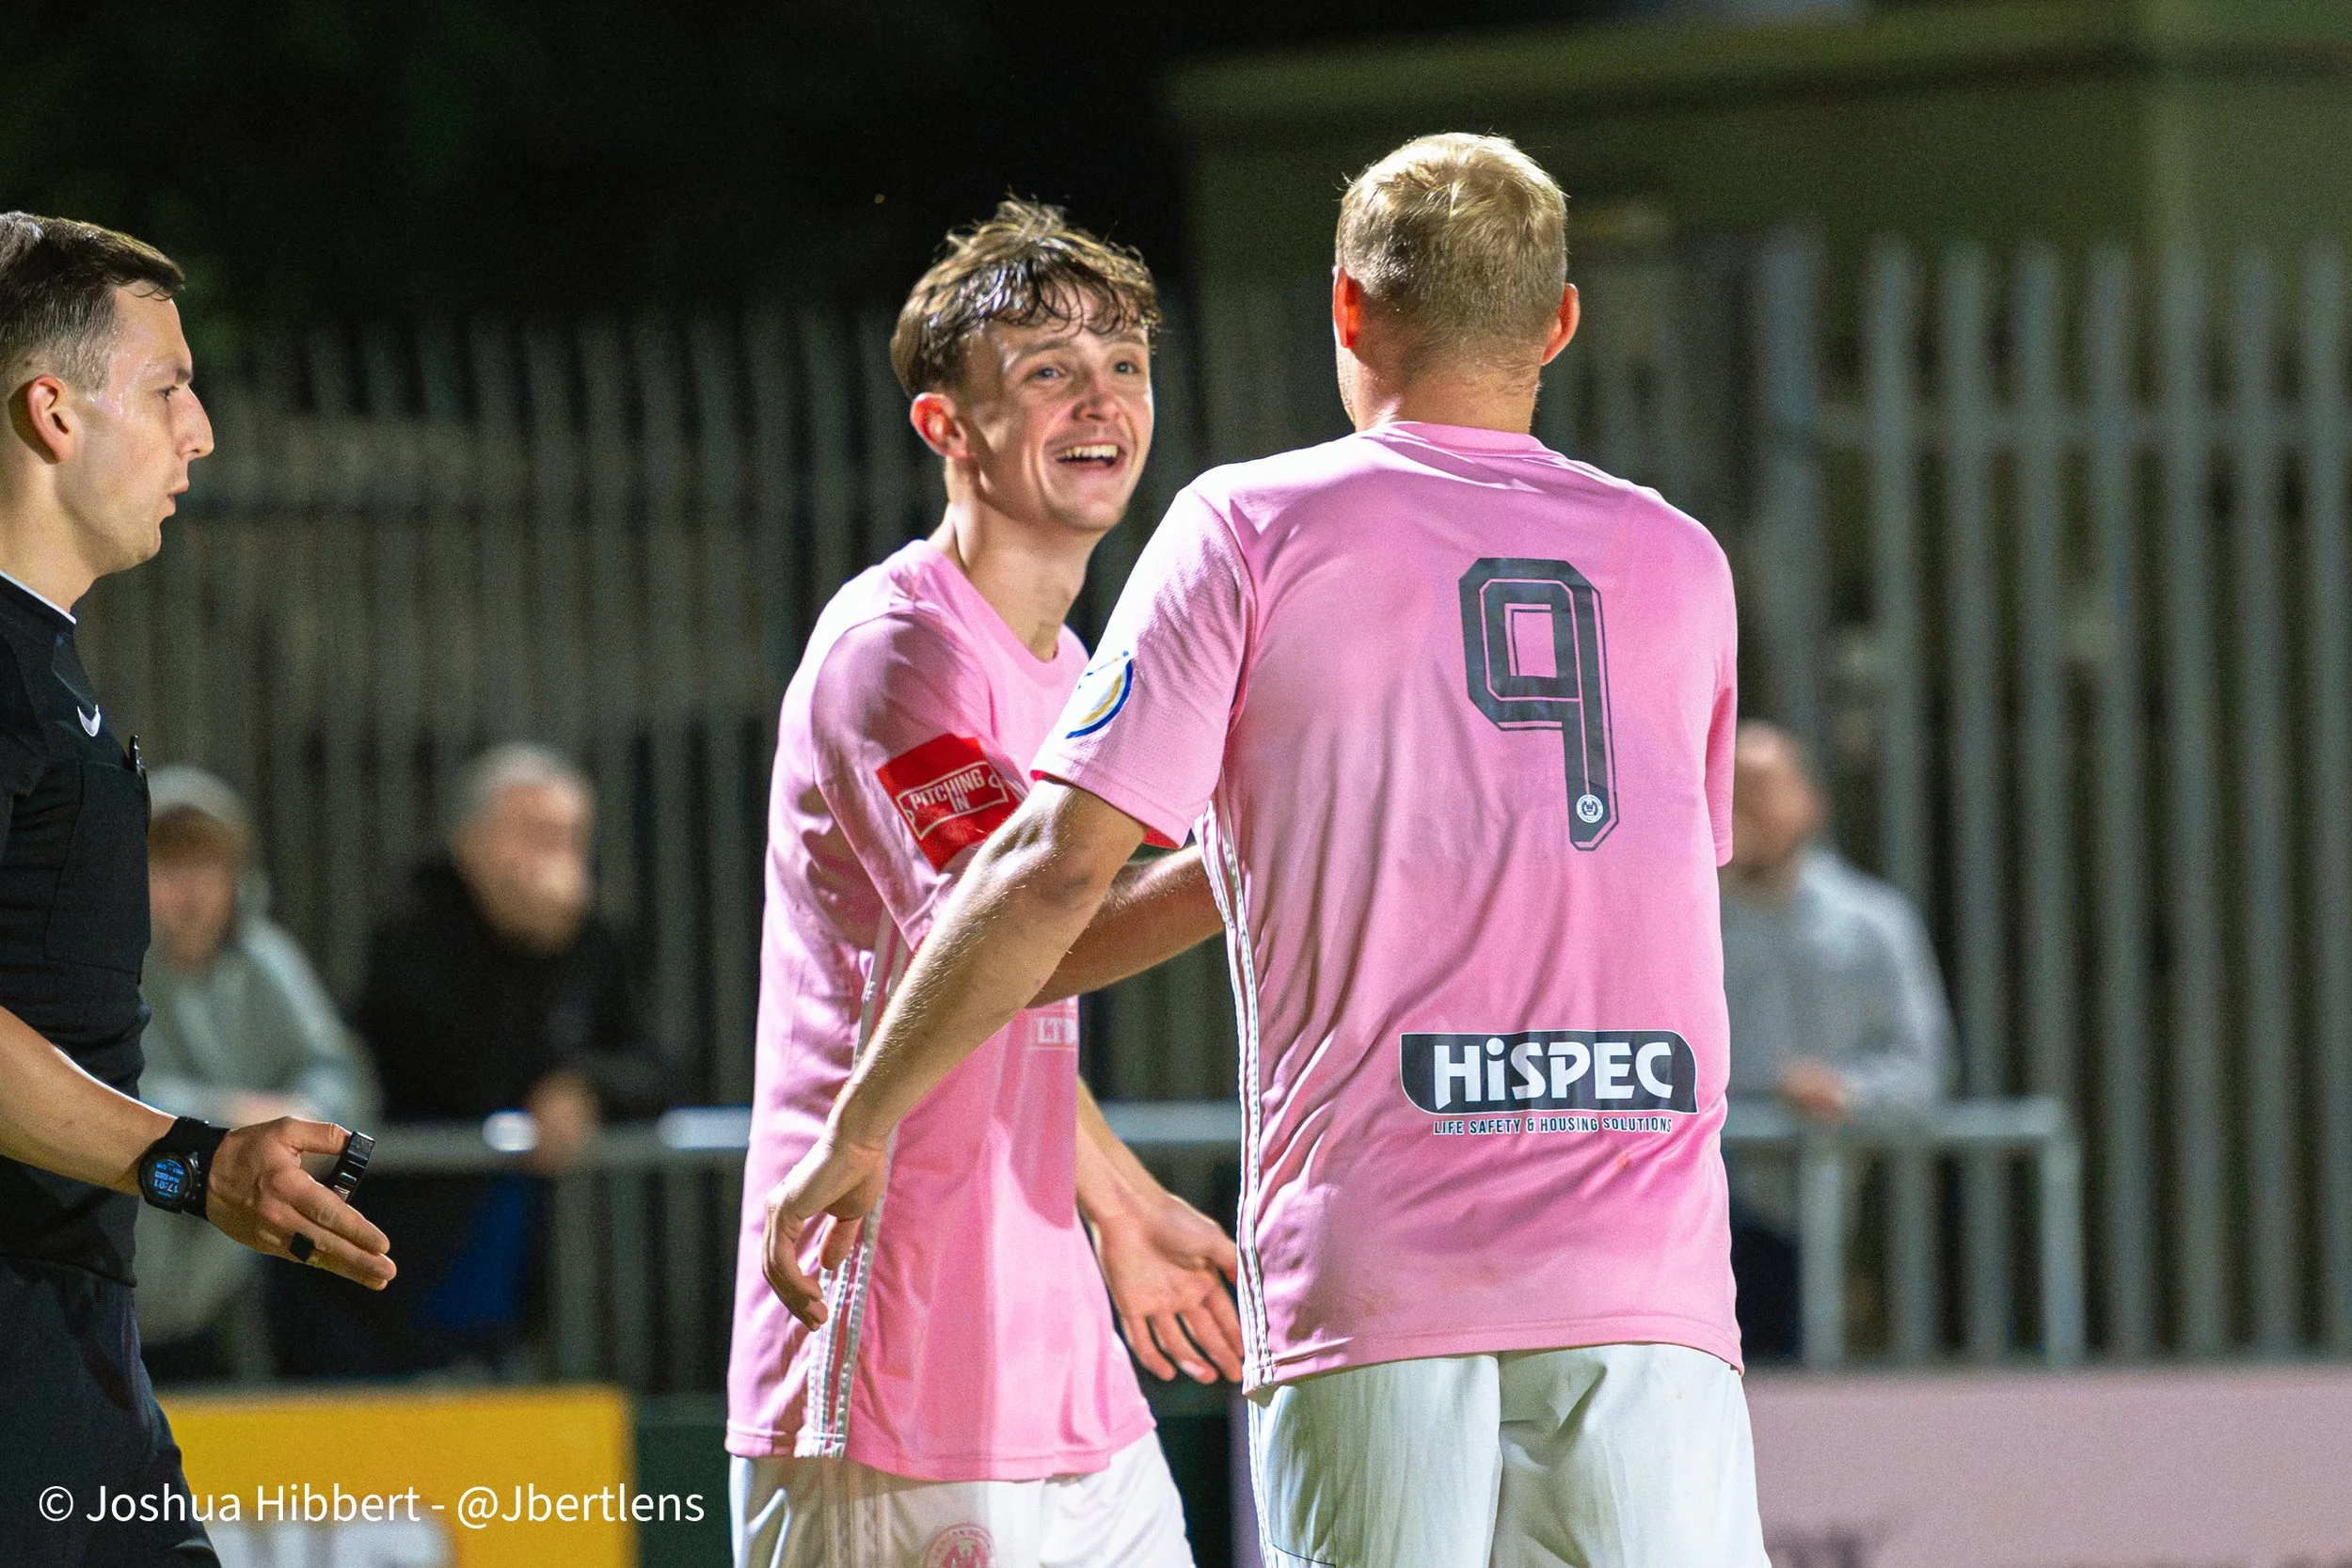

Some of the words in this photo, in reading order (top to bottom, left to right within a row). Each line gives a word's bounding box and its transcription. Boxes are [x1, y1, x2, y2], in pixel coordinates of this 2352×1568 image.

[1458, 558, 1619, 851] 9
[910, 768, 985, 809] PITCHING
[951, 797, 971, 813] IN
[1433, 1120, 1464, 1134] LIFE
[1469, 1118, 1521, 1133] SAFETY
[1526, 1117, 1535, 1132] &
[1539, 1117, 1598, 1132] HOUSING
[1602, 1117, 1673, 1132] SOLUTIONS
